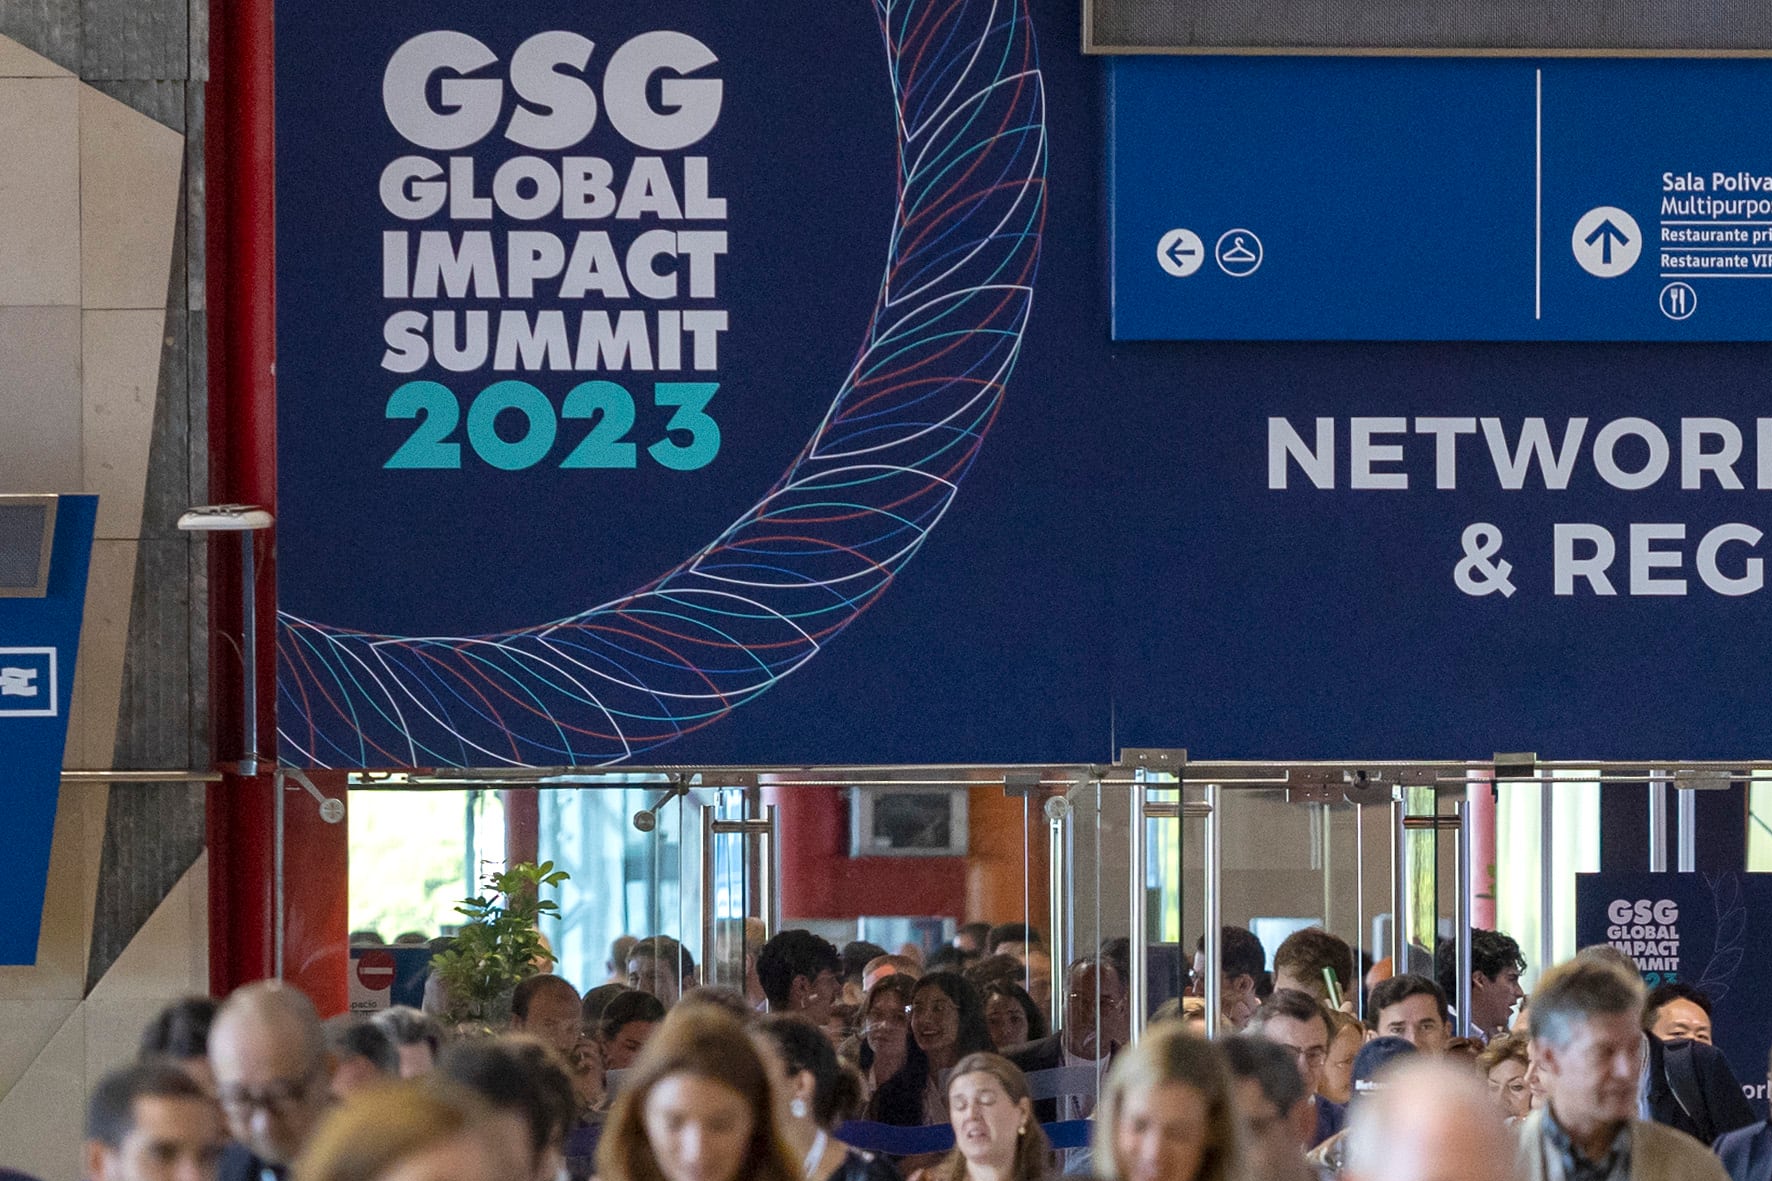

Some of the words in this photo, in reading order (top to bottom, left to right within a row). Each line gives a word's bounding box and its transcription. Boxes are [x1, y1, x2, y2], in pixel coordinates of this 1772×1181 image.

[382, 29, 724, 151] GSG
[378, 155, 728, 221] GLOBAL
[1662, 171, 1706, 193] Sala
[1660, 226, 1749, 244] Restaurante
[382, 228, 728, 300] IMPACT
[1660, 253, 1749, 270] Restaurante
[380, 309, 729, 373] SUMMIT
[382, 379, 722, 471] 2023
[1453, 522, 1517, 598] &
[1607, 899, 1679, 925] GSG
[1607, 925, 1679, 940] GLOBAL
[1632, 957, 1680, 971] MMIT
